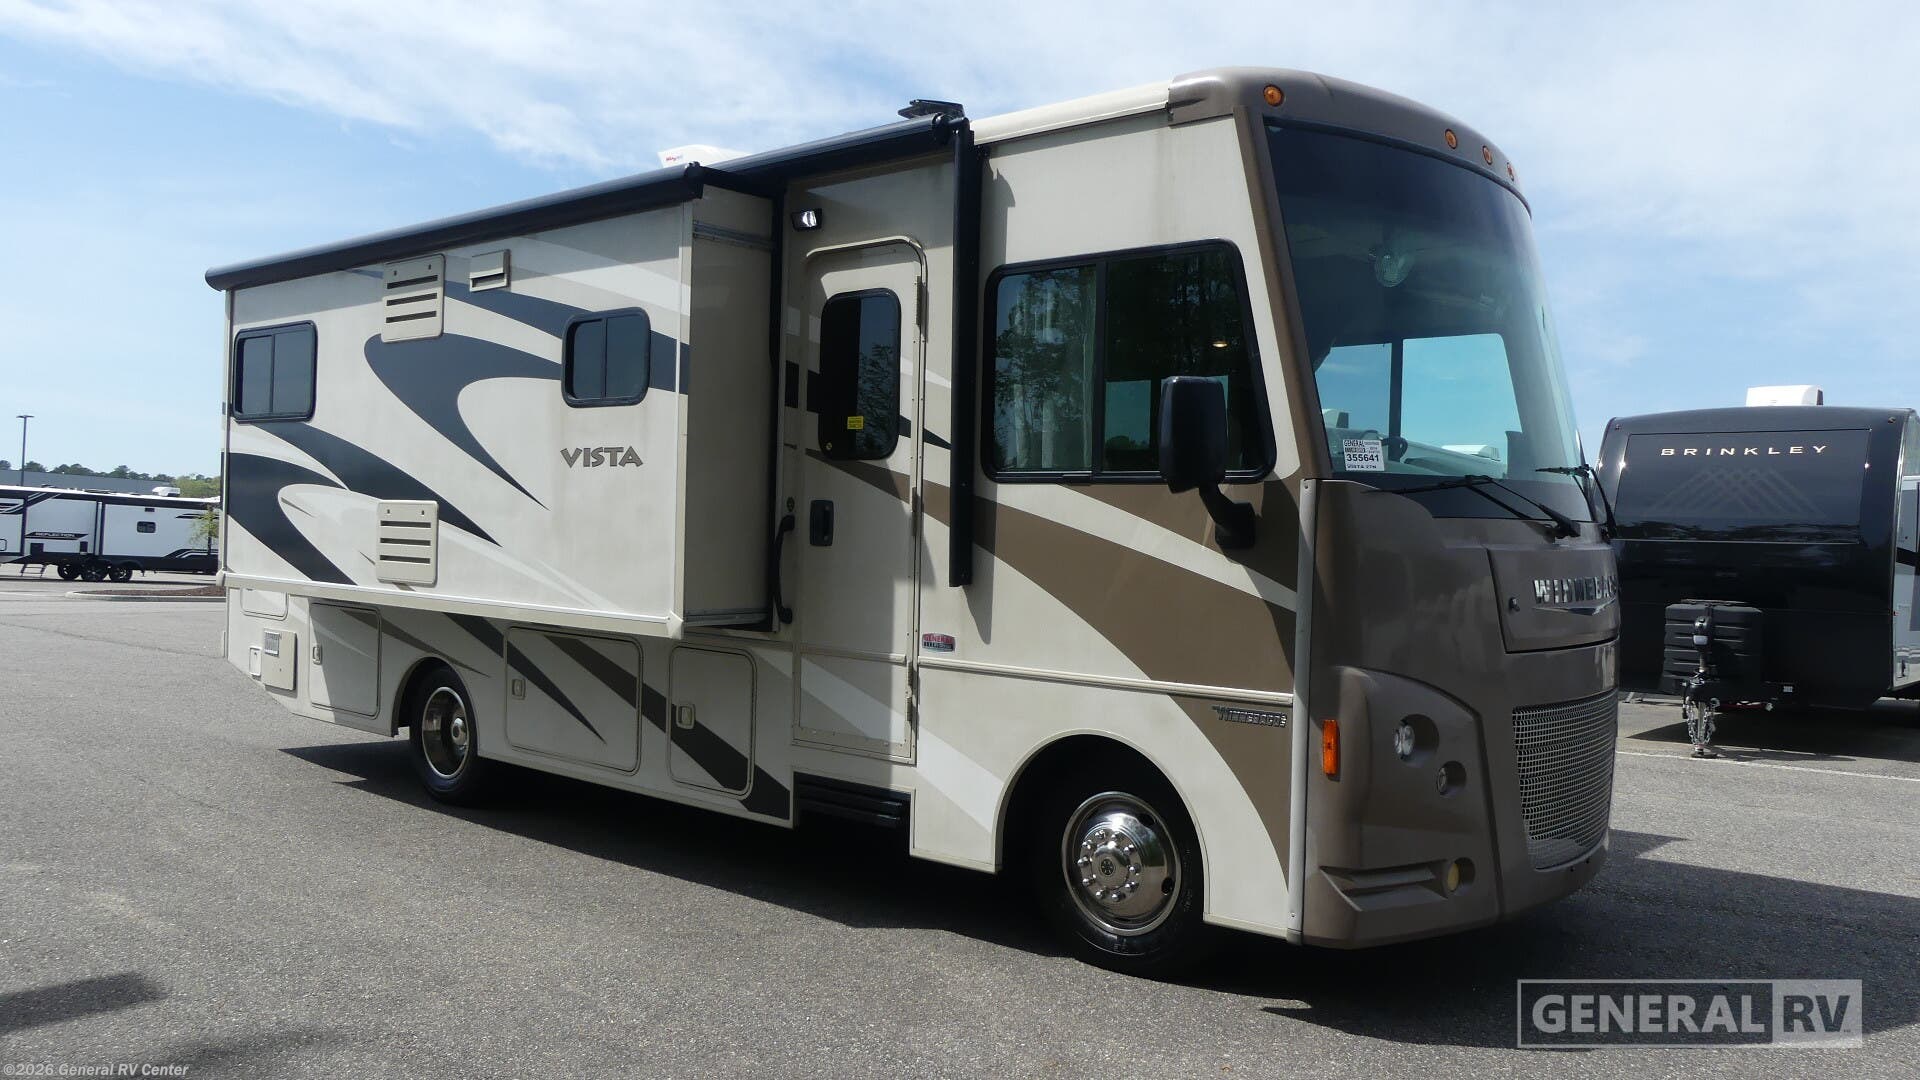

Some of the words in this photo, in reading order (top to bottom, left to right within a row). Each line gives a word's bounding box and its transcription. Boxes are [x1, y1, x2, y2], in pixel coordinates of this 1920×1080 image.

[1660, 445, 1828, 456] BRINKLEY
[560, 446, 644, 468] VISTA
[1346, 453, 1379, 462] 355641
